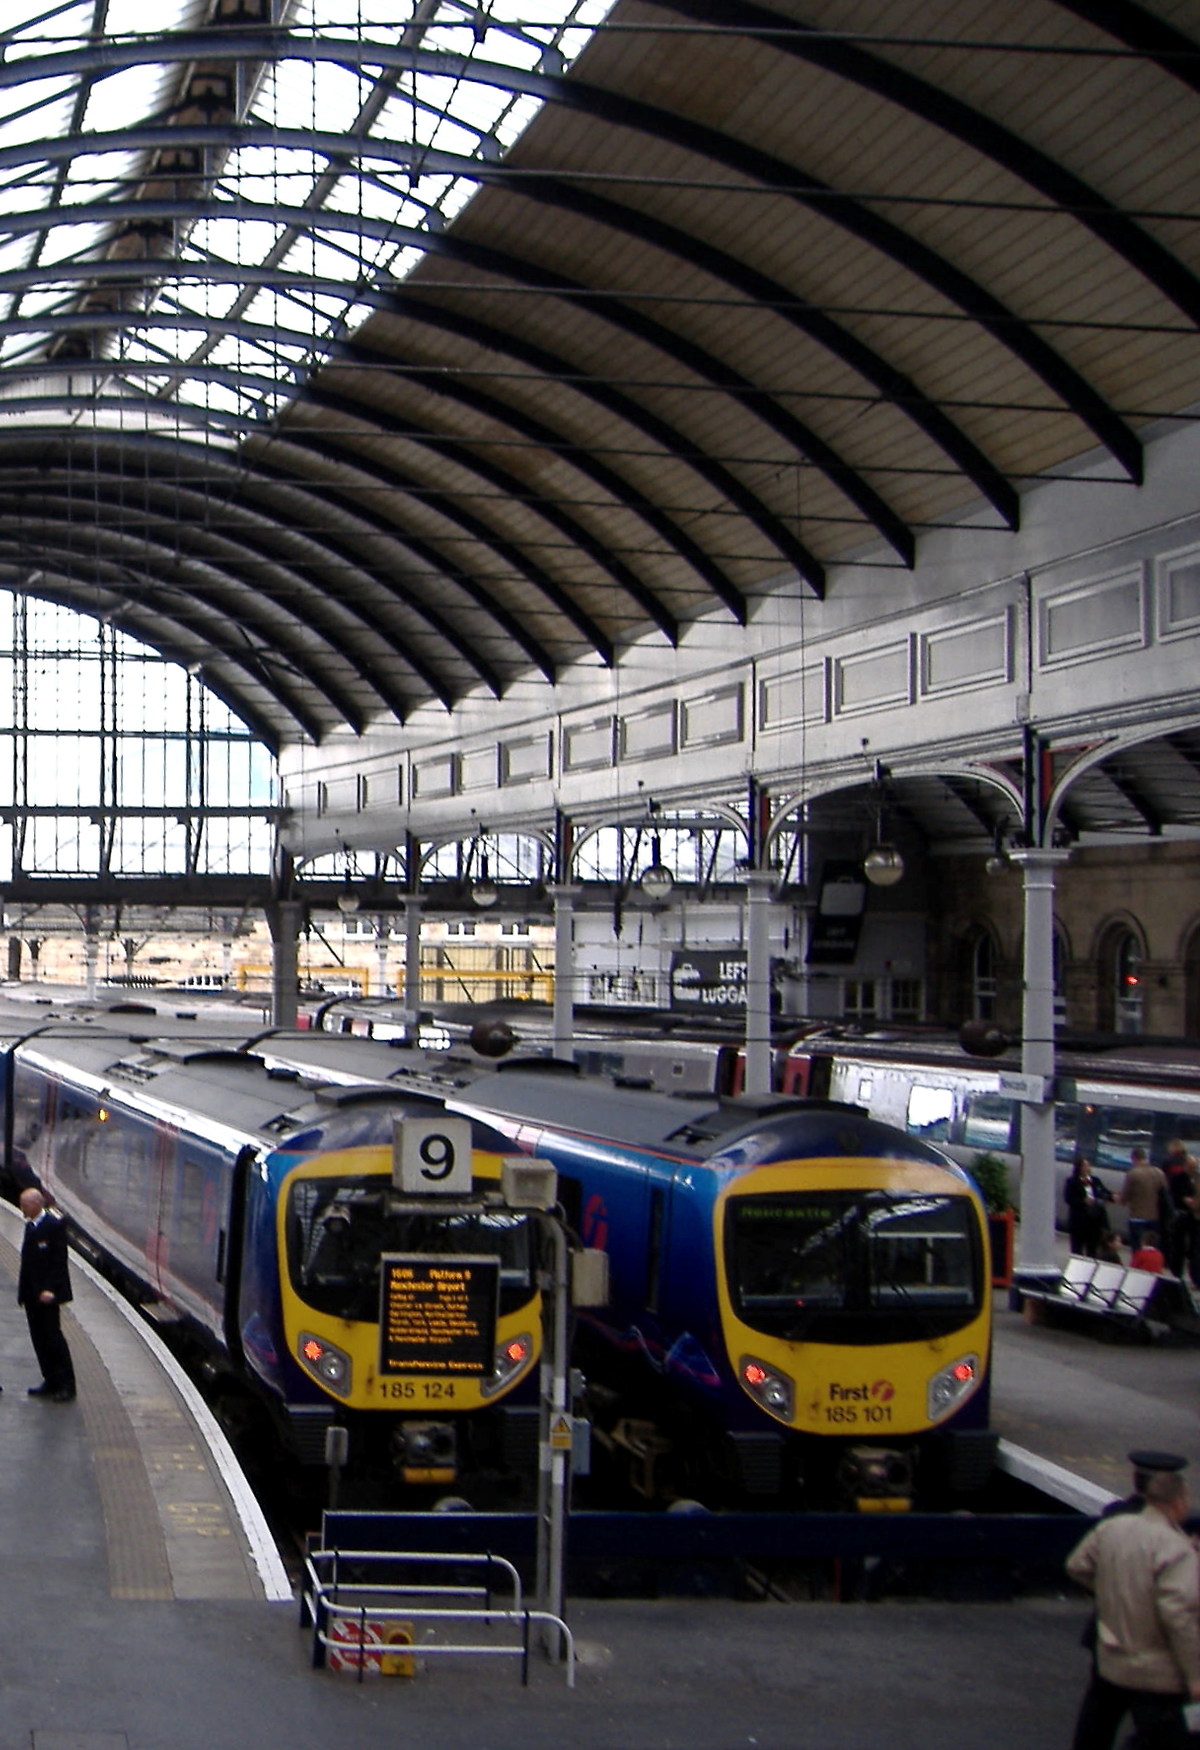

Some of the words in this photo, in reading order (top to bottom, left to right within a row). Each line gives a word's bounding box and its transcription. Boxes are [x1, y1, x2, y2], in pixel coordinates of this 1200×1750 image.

[702, 986, 748, 1004] LUGGA
[420, 1132, 455, 1180] 9
[380, 1382, 415, 1399] 185
[422, 1382, 456, 1399] 124
[828, 1383, 869, 1401] First
[825, 1406, 858, 1422] 185
[863, 1406, 892, 1422] 101
